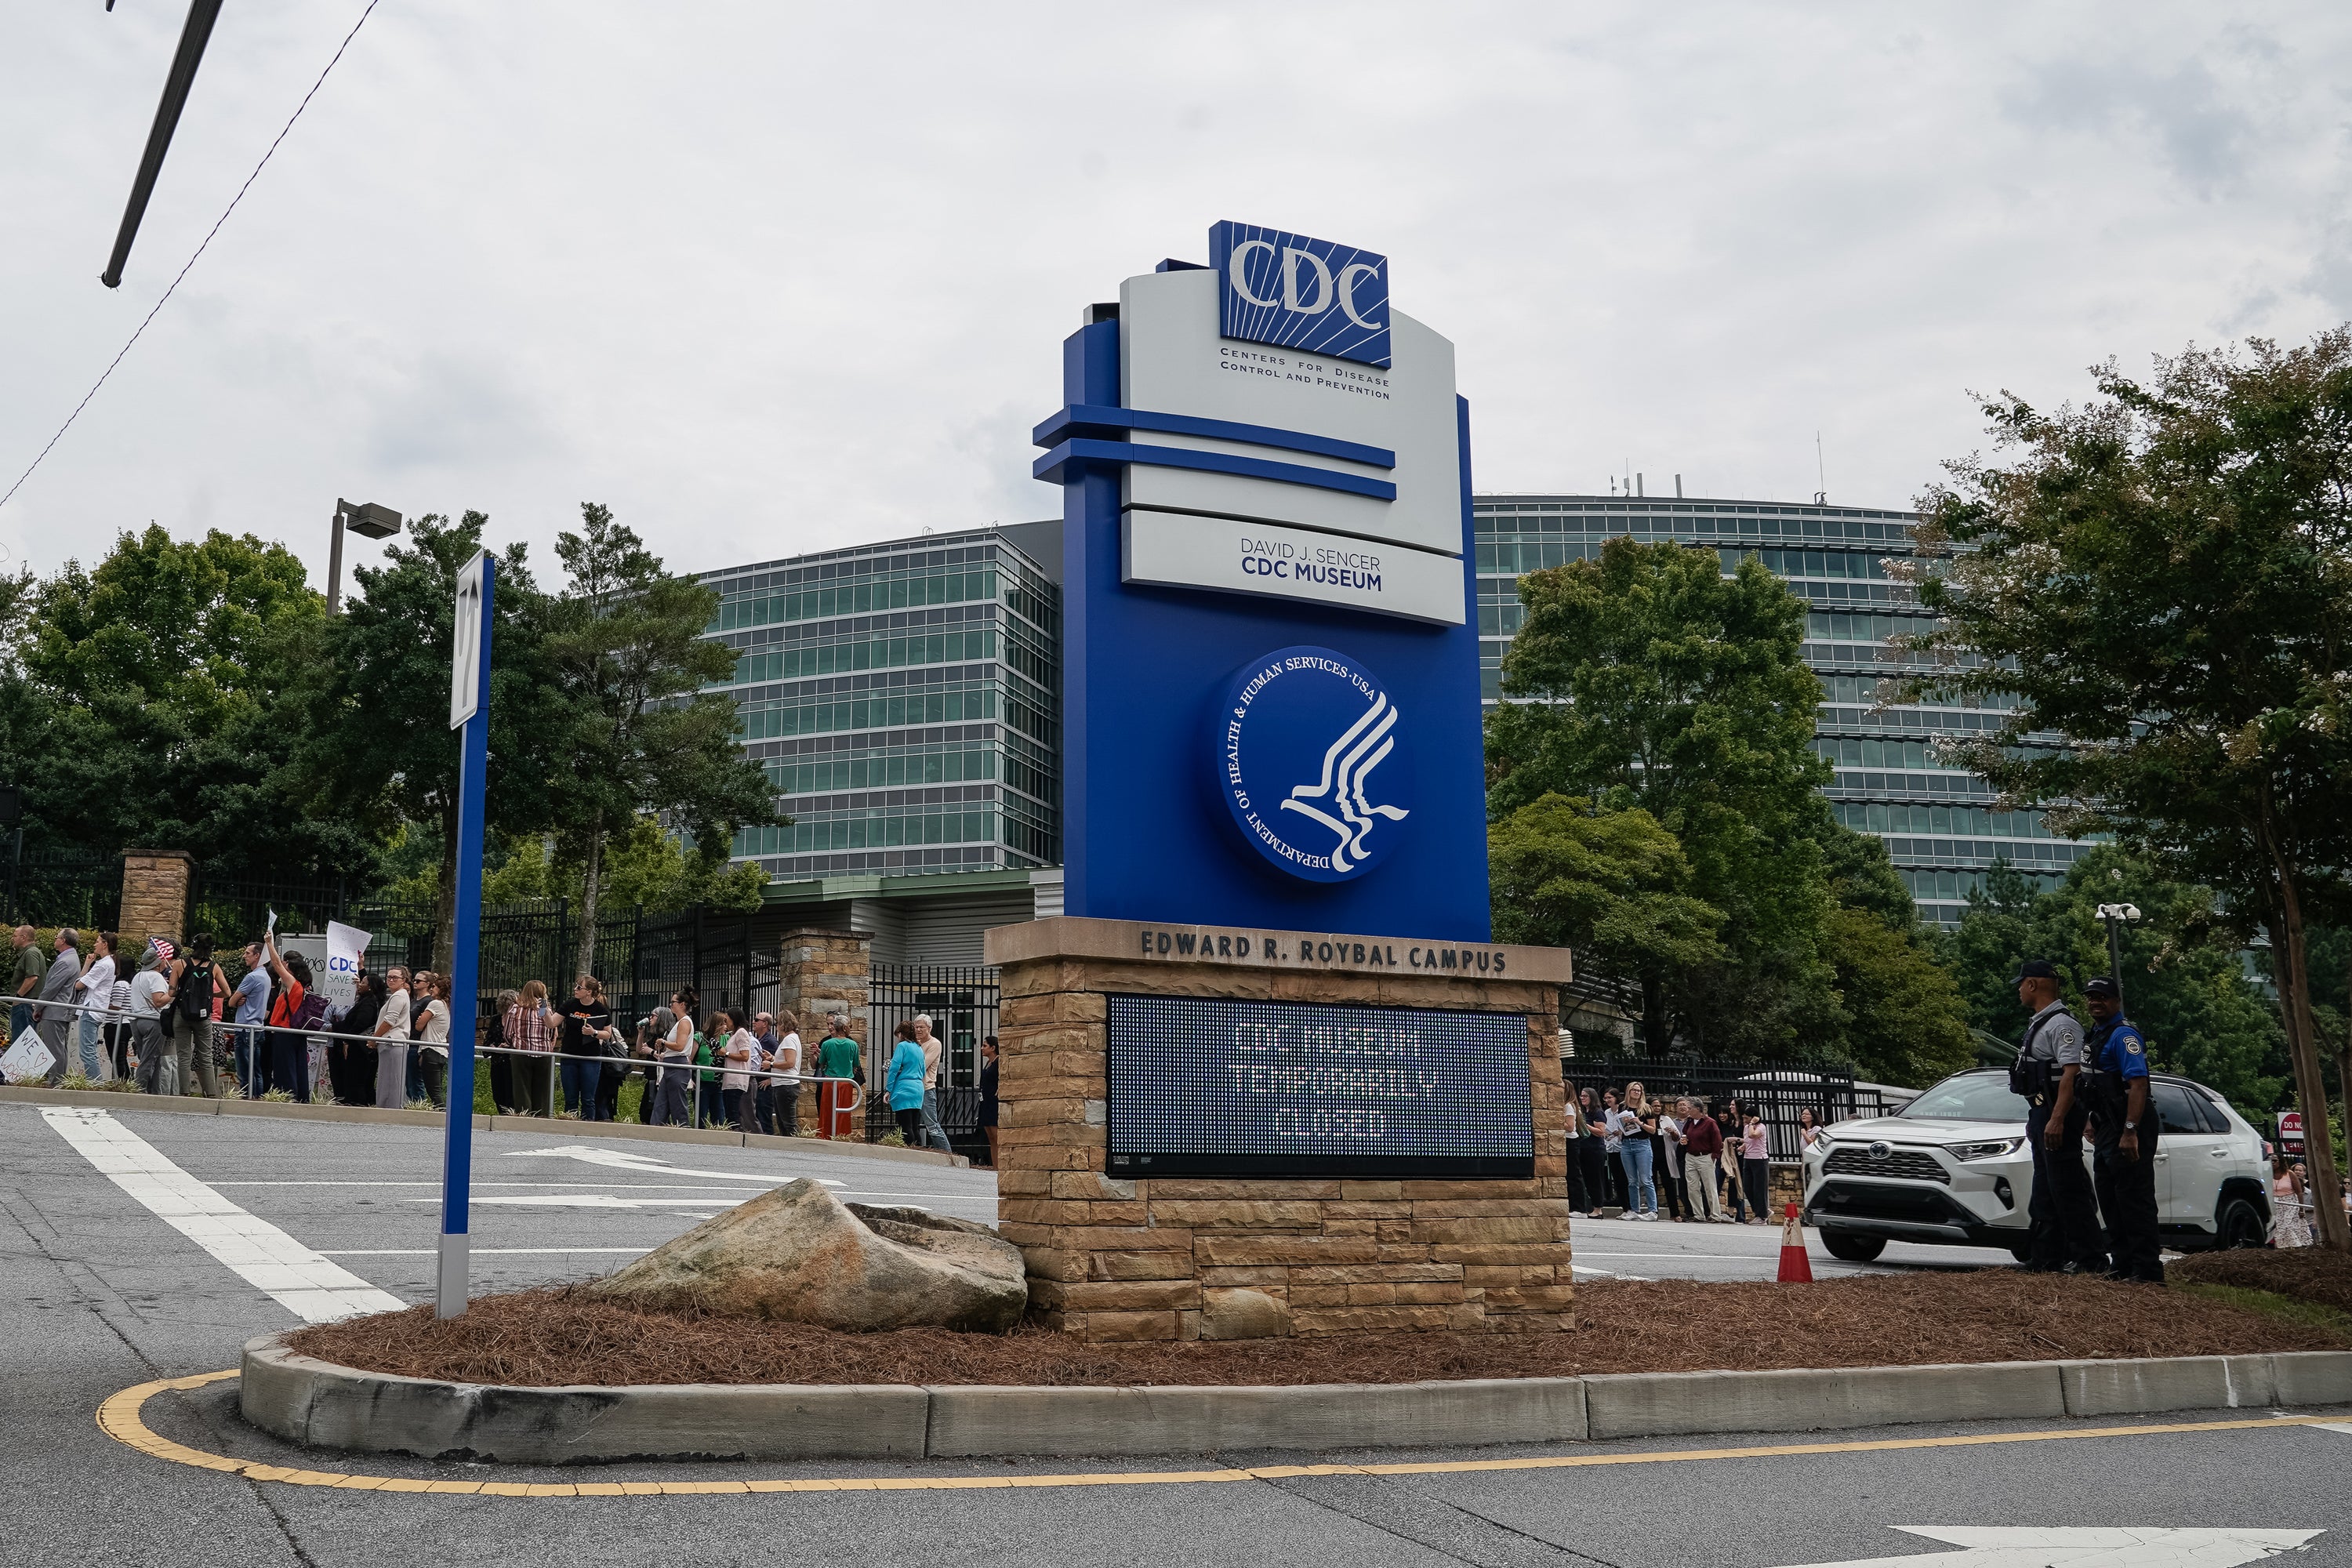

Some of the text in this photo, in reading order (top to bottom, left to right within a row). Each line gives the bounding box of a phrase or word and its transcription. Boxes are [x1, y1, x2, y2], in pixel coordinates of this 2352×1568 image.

[1229, 240, 1381, 330] CDC
[1287, 373, 1311, 383] AND
[1298, 361, 1323, 372] FOR
[1241, 538, 1381, 572] DAVID J. SENCER
[1241, 556, 1381, 592] CDC MUSEUM
[1285, 656, 1348, 678] SERVICES
[1240, 662, 1283, 706] HUMAN
[1234, 706, 1247, 718] &
[1227, 720, 1243, 785] HEALTH
[1234, 789, 1250, 809] OF
[1246, 811, 1330, 869] DEPARTMENT
[329, 956, 358, 973] CDC
[1142, 931, 1506, 972] EDWARD R. ROYBAL CAMPUS
[324, 987, 352, 997] LIVES
[21, 1030, 39, 1055] WE
[1235, 1022, 1418, 1057] CDC MUSEUM
[1229, 1064, 1437, 1098] TEMPORARILY
[1276, 1108, 1385, 1138] CLOSED
